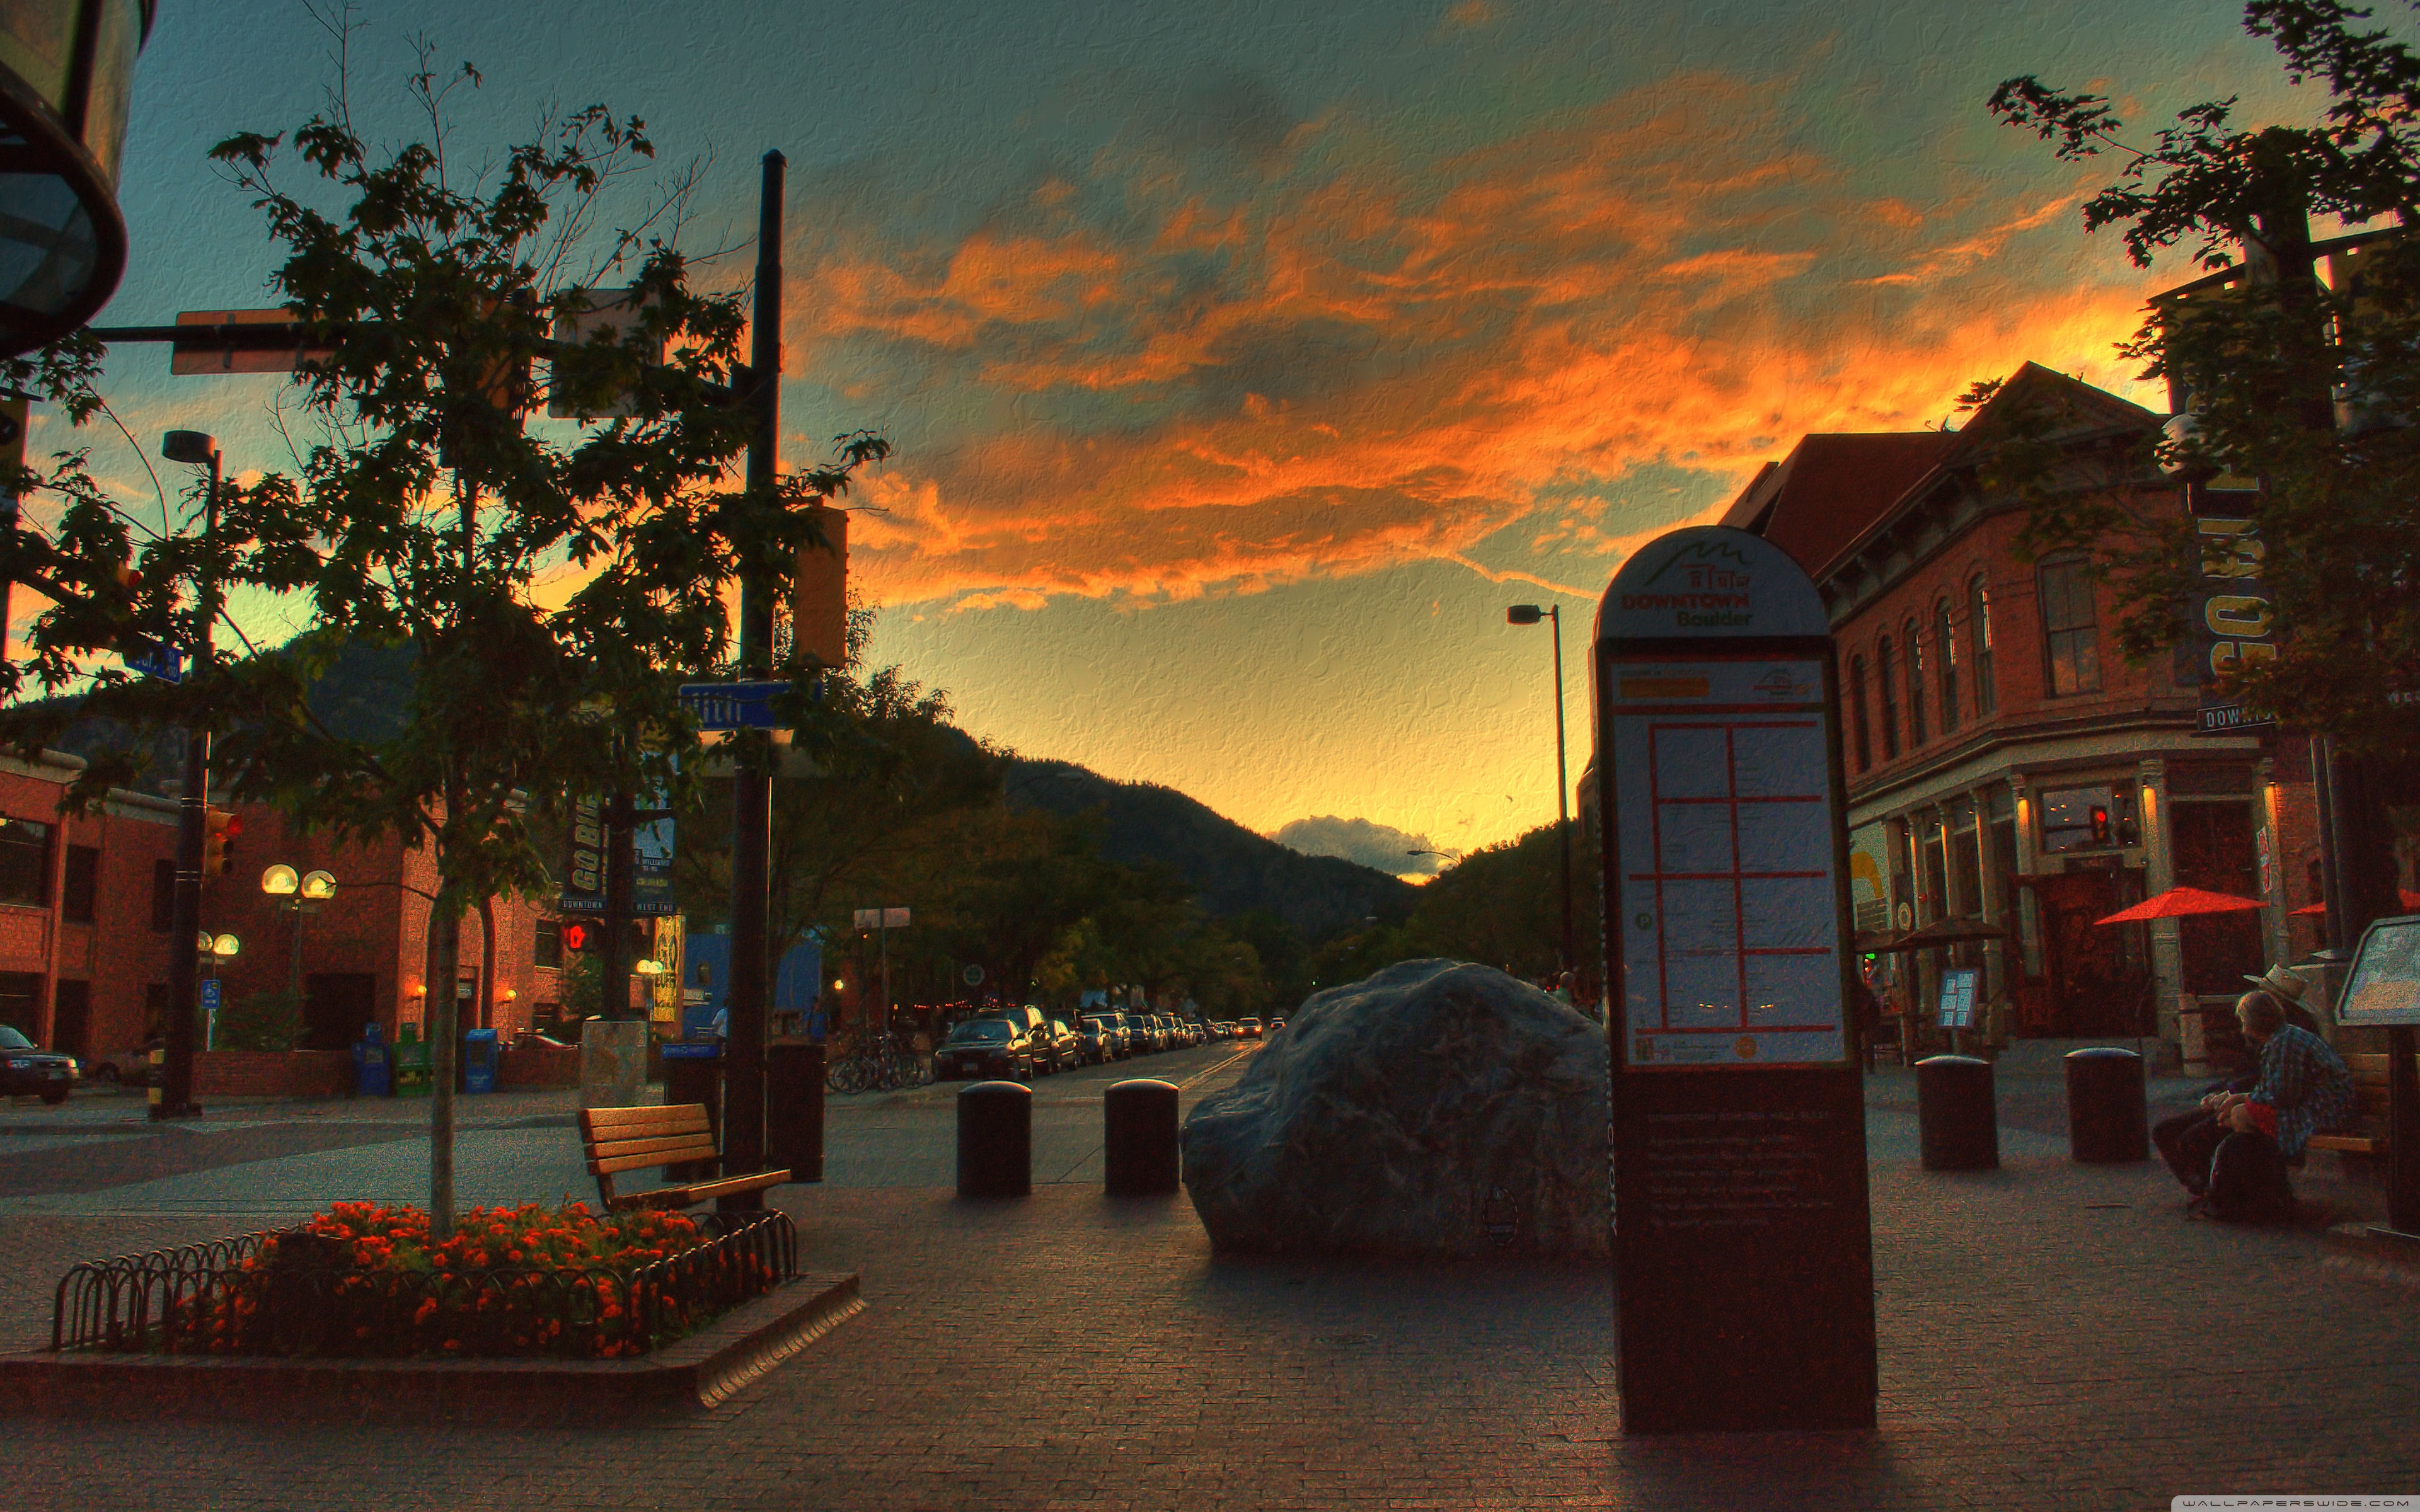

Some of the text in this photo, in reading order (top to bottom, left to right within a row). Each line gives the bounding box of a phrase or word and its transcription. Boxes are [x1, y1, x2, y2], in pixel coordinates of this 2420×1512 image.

[1621, 592, 1749, 610] DOWNTOWN
[1676, 610, 1753, 627] Boulder
[572, 849, 599, 891] GO
[563, 899, 603, 909] DOWNTOWN
[637, 903, 674, 912] WEST END
